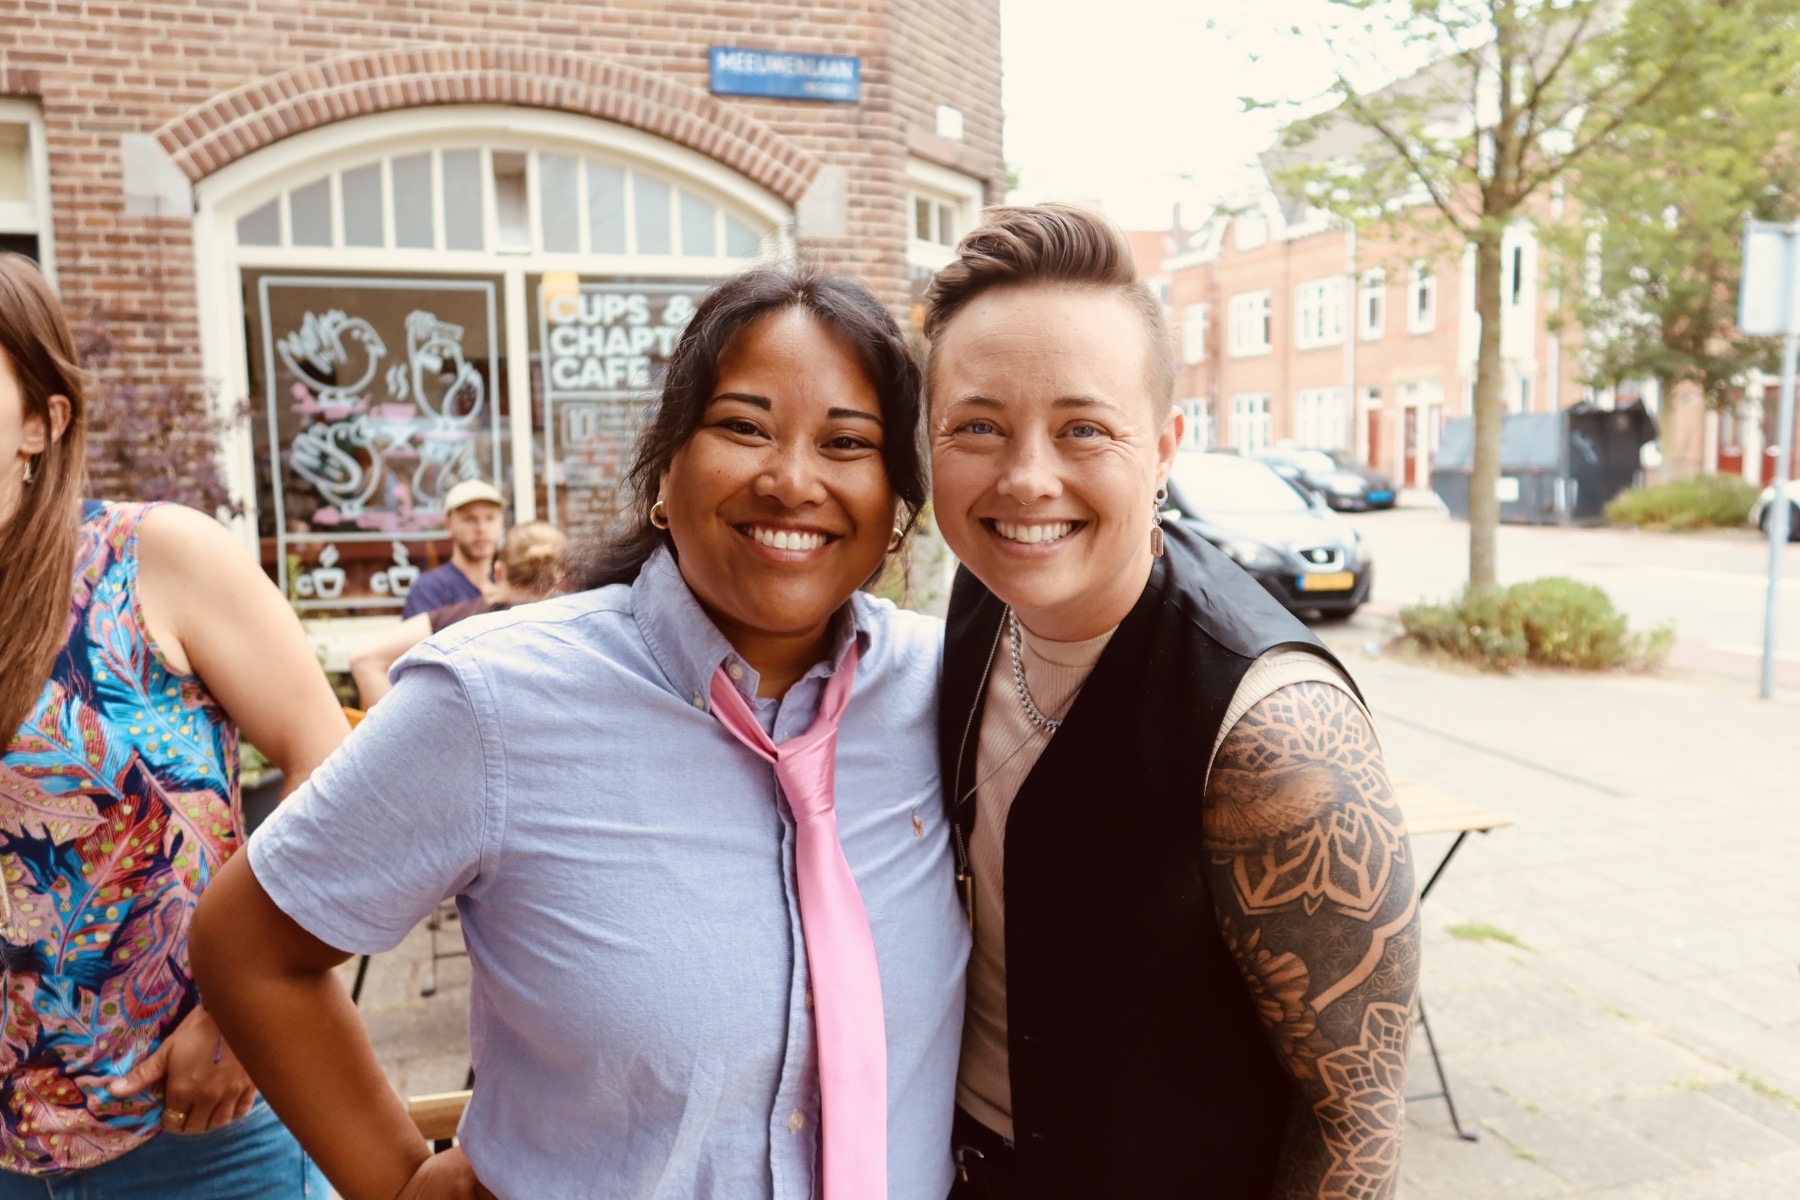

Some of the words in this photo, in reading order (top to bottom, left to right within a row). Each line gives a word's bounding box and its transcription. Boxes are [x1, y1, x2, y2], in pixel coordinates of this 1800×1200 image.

[550, 294, 650, 325] CUPS
[663, 294, 697, 325] &
[551, 357, 651, 388] CAFE
